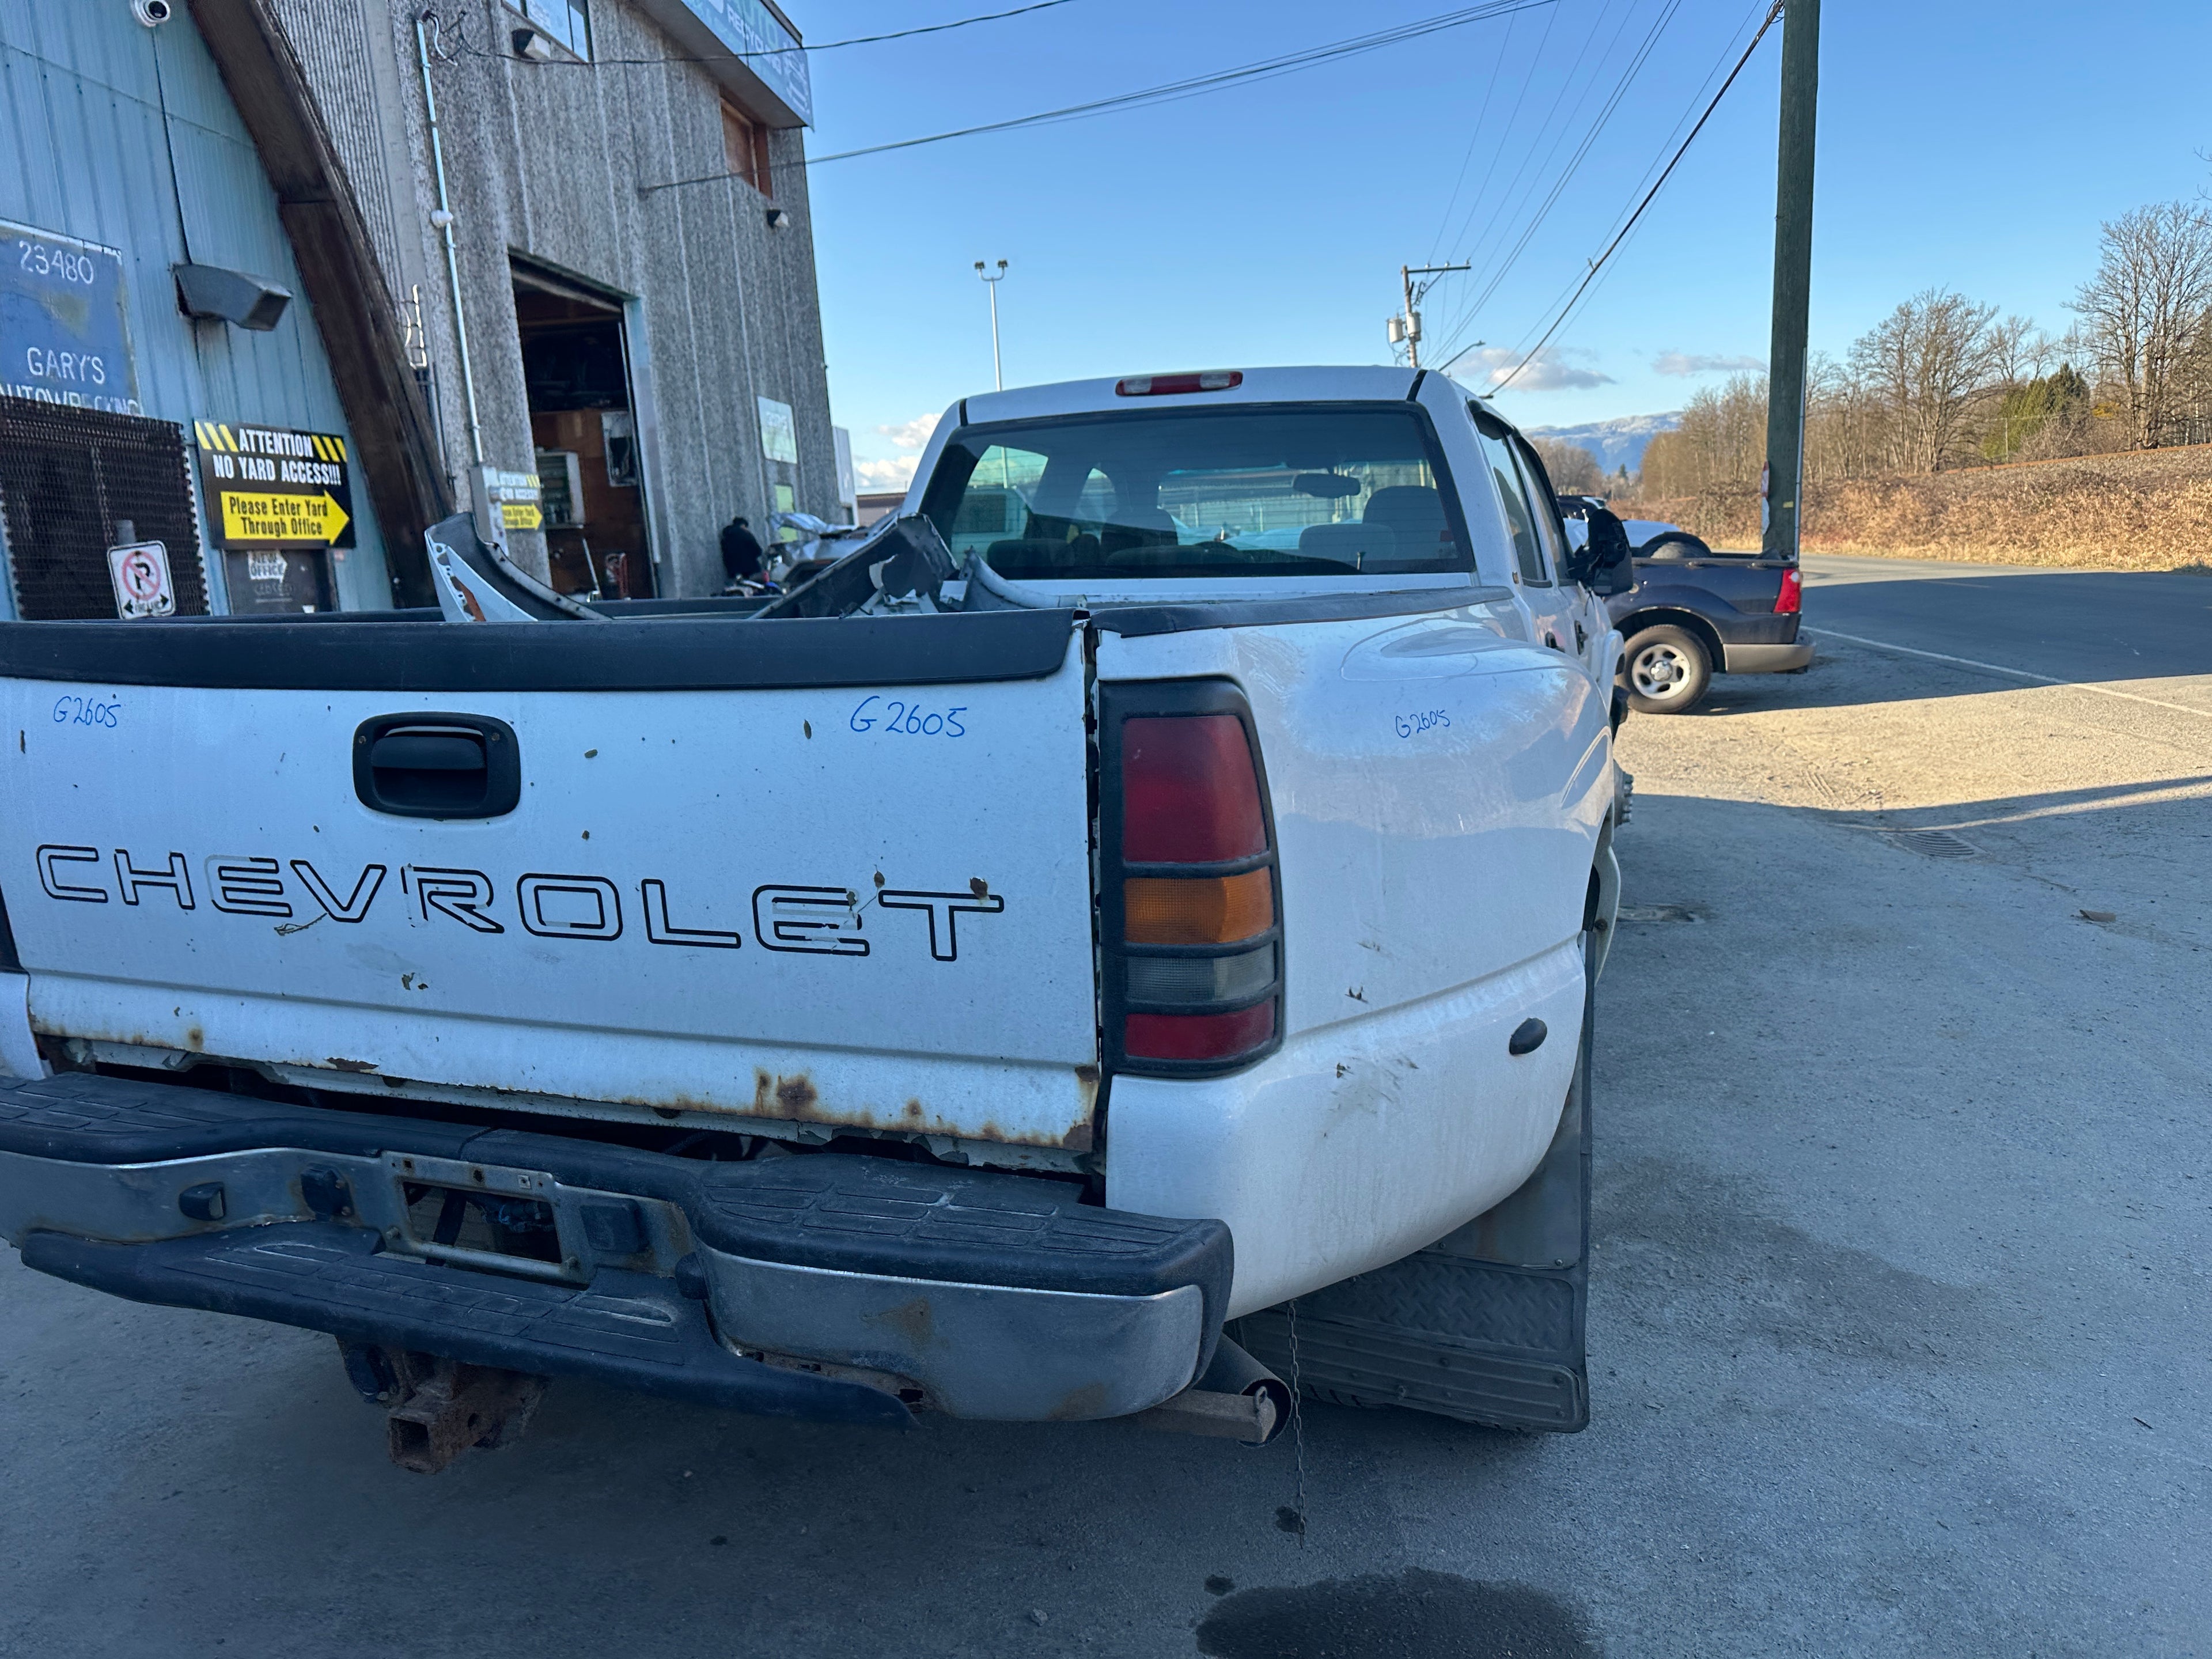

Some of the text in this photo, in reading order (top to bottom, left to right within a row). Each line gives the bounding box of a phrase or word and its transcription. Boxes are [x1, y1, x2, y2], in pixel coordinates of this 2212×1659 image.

[18, 240, 94, 284] 23480
[26, 347, 106, 385] GARY'S
[239, 428, 314, 458] ATTENTION
[213, 454, 342, 486] NO YARD ACCESS!!!
[229, 496, 328, 517] Please Enter Yard
[241, 516, 323, 537] Through Office
[53, 696, 121, 728] G2605
[1395, 709, 1451, 740] G2605
[36, 844, 1004, 962] CHEVROLET
